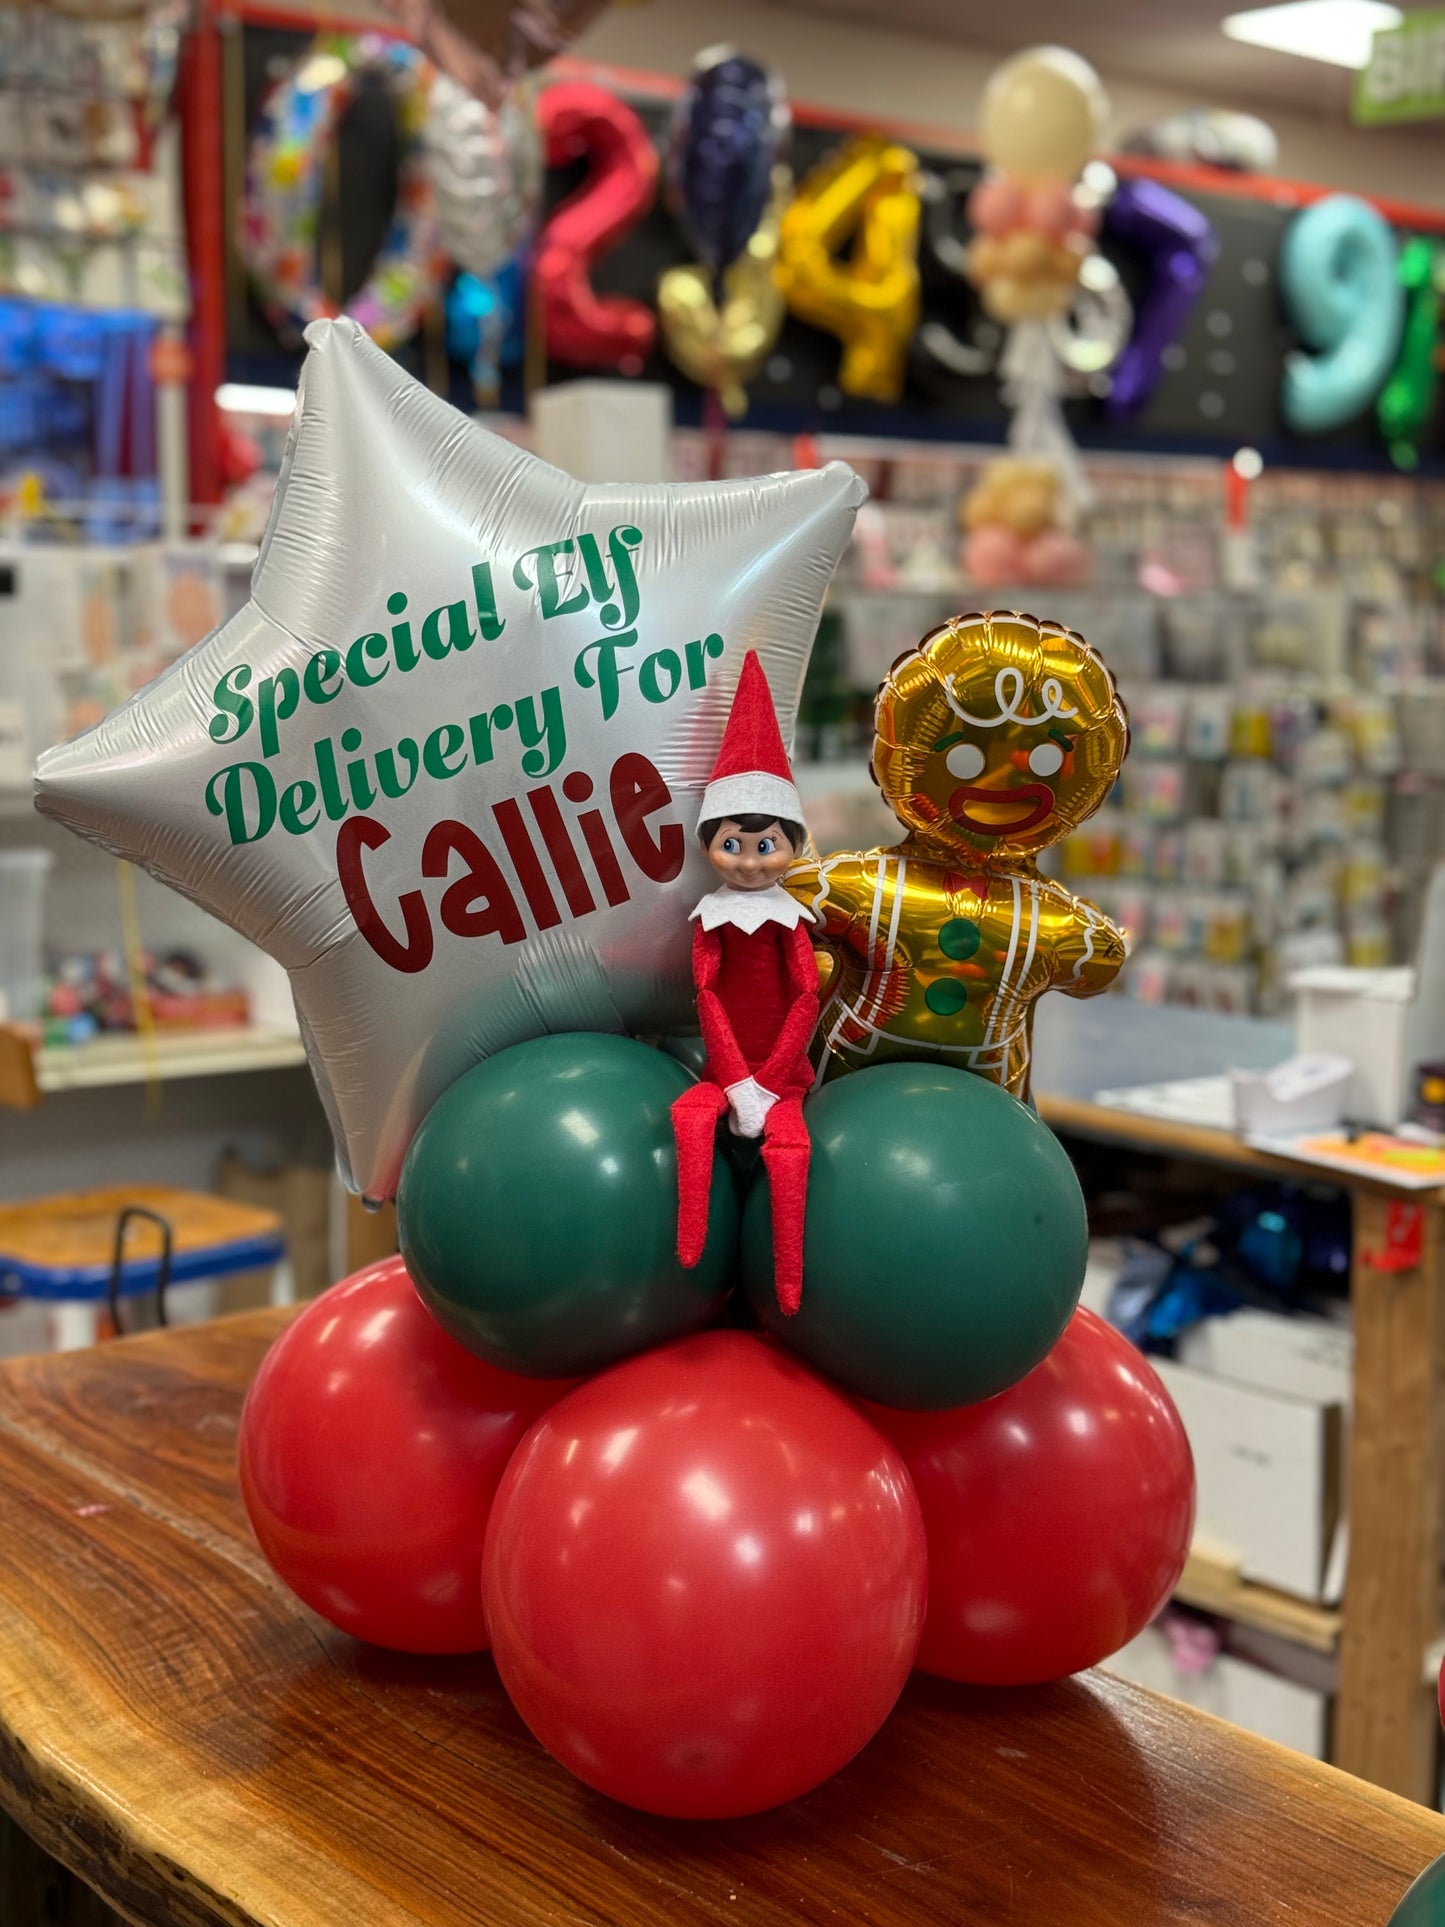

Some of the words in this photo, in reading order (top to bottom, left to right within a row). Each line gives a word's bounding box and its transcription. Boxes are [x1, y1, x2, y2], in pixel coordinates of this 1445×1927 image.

[536, 80, 660, 368] 2
[776, 138, 922, 402] 4
[1282, 193, 1404, 432] 9
[205, 686, 566, 846] Delivery
[574, 628, 724, 721] For
[209, 566, 504, 758] Special
[513, 525, 643, 629] Elf
[336, 753, 685, 973] Callie
